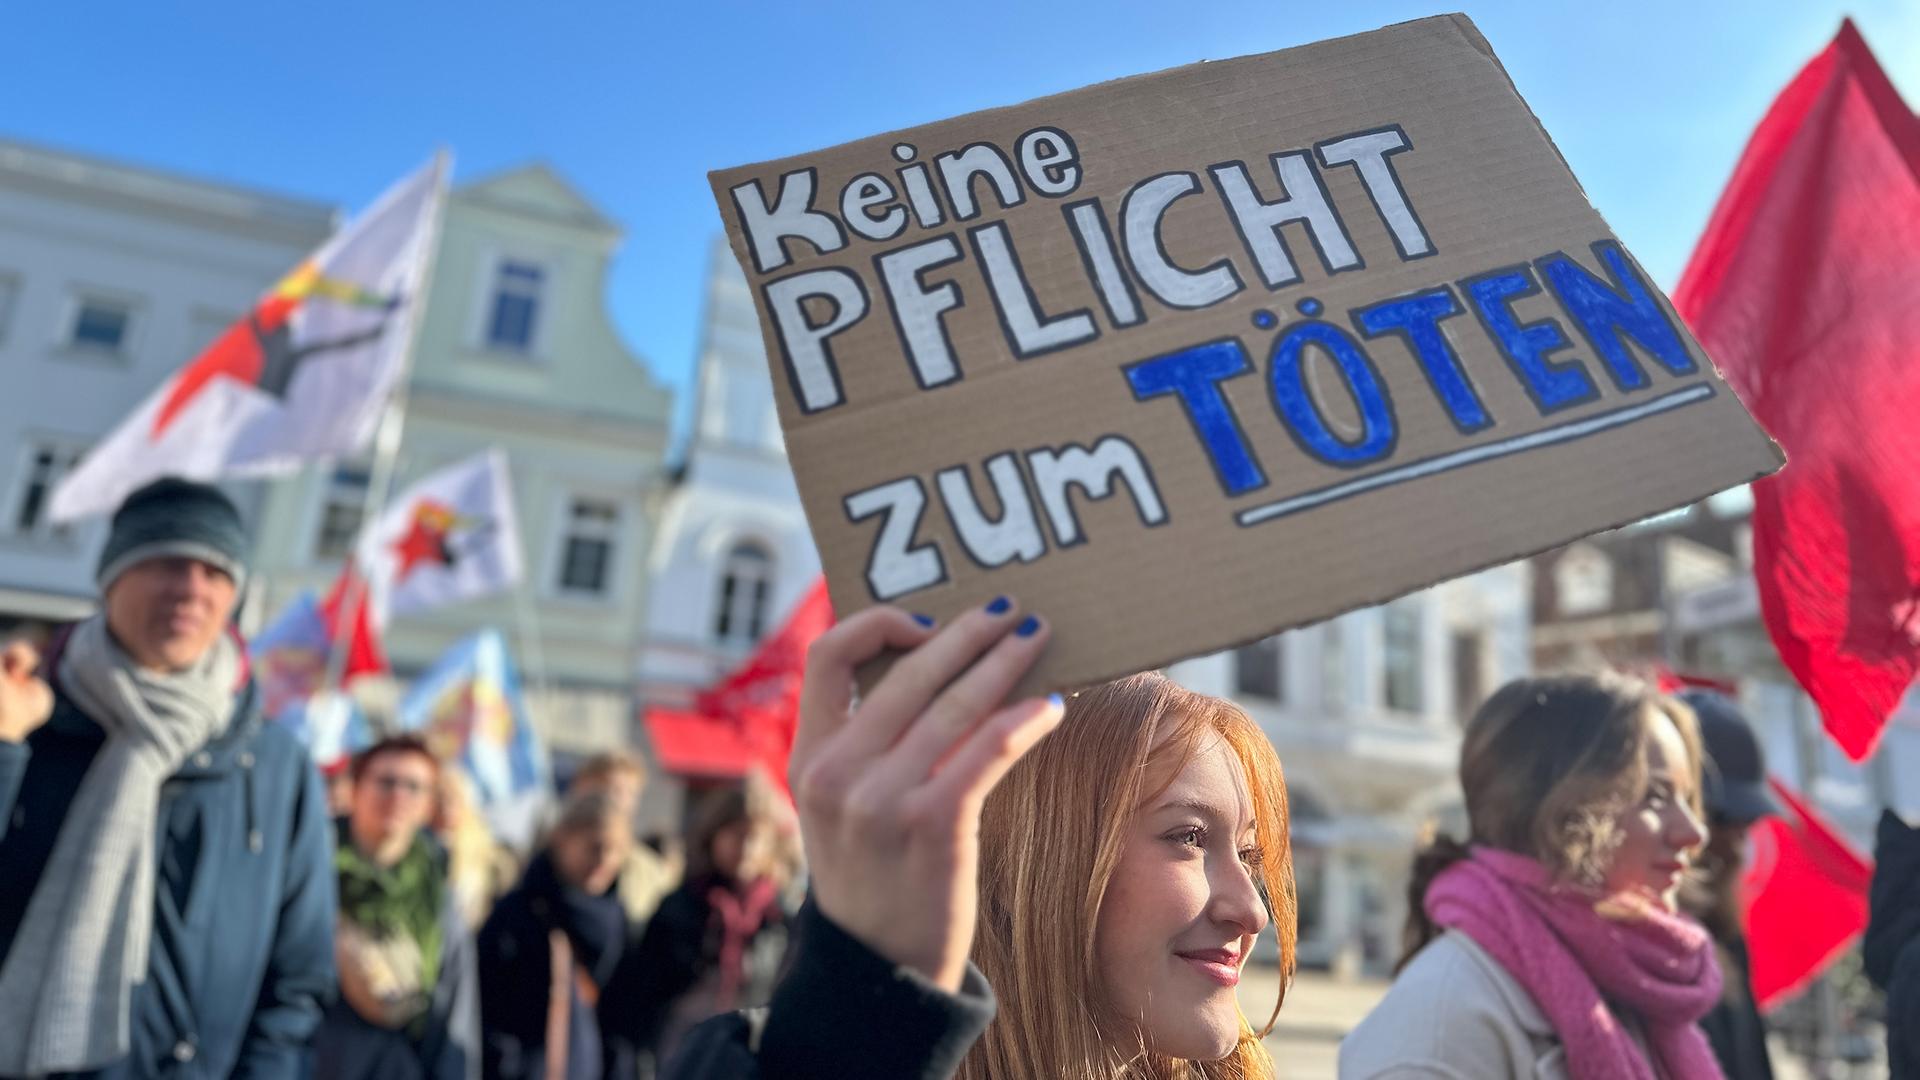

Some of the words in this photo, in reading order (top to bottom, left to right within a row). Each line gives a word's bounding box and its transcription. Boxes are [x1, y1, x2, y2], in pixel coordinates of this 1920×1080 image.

[730, 126, 1082, 274] Keine
[760, 124, 1438, 415] PFLICHT
[842, 435, 1170, 602] zum
[1121, 239, 1699, 497] TÖTEN
